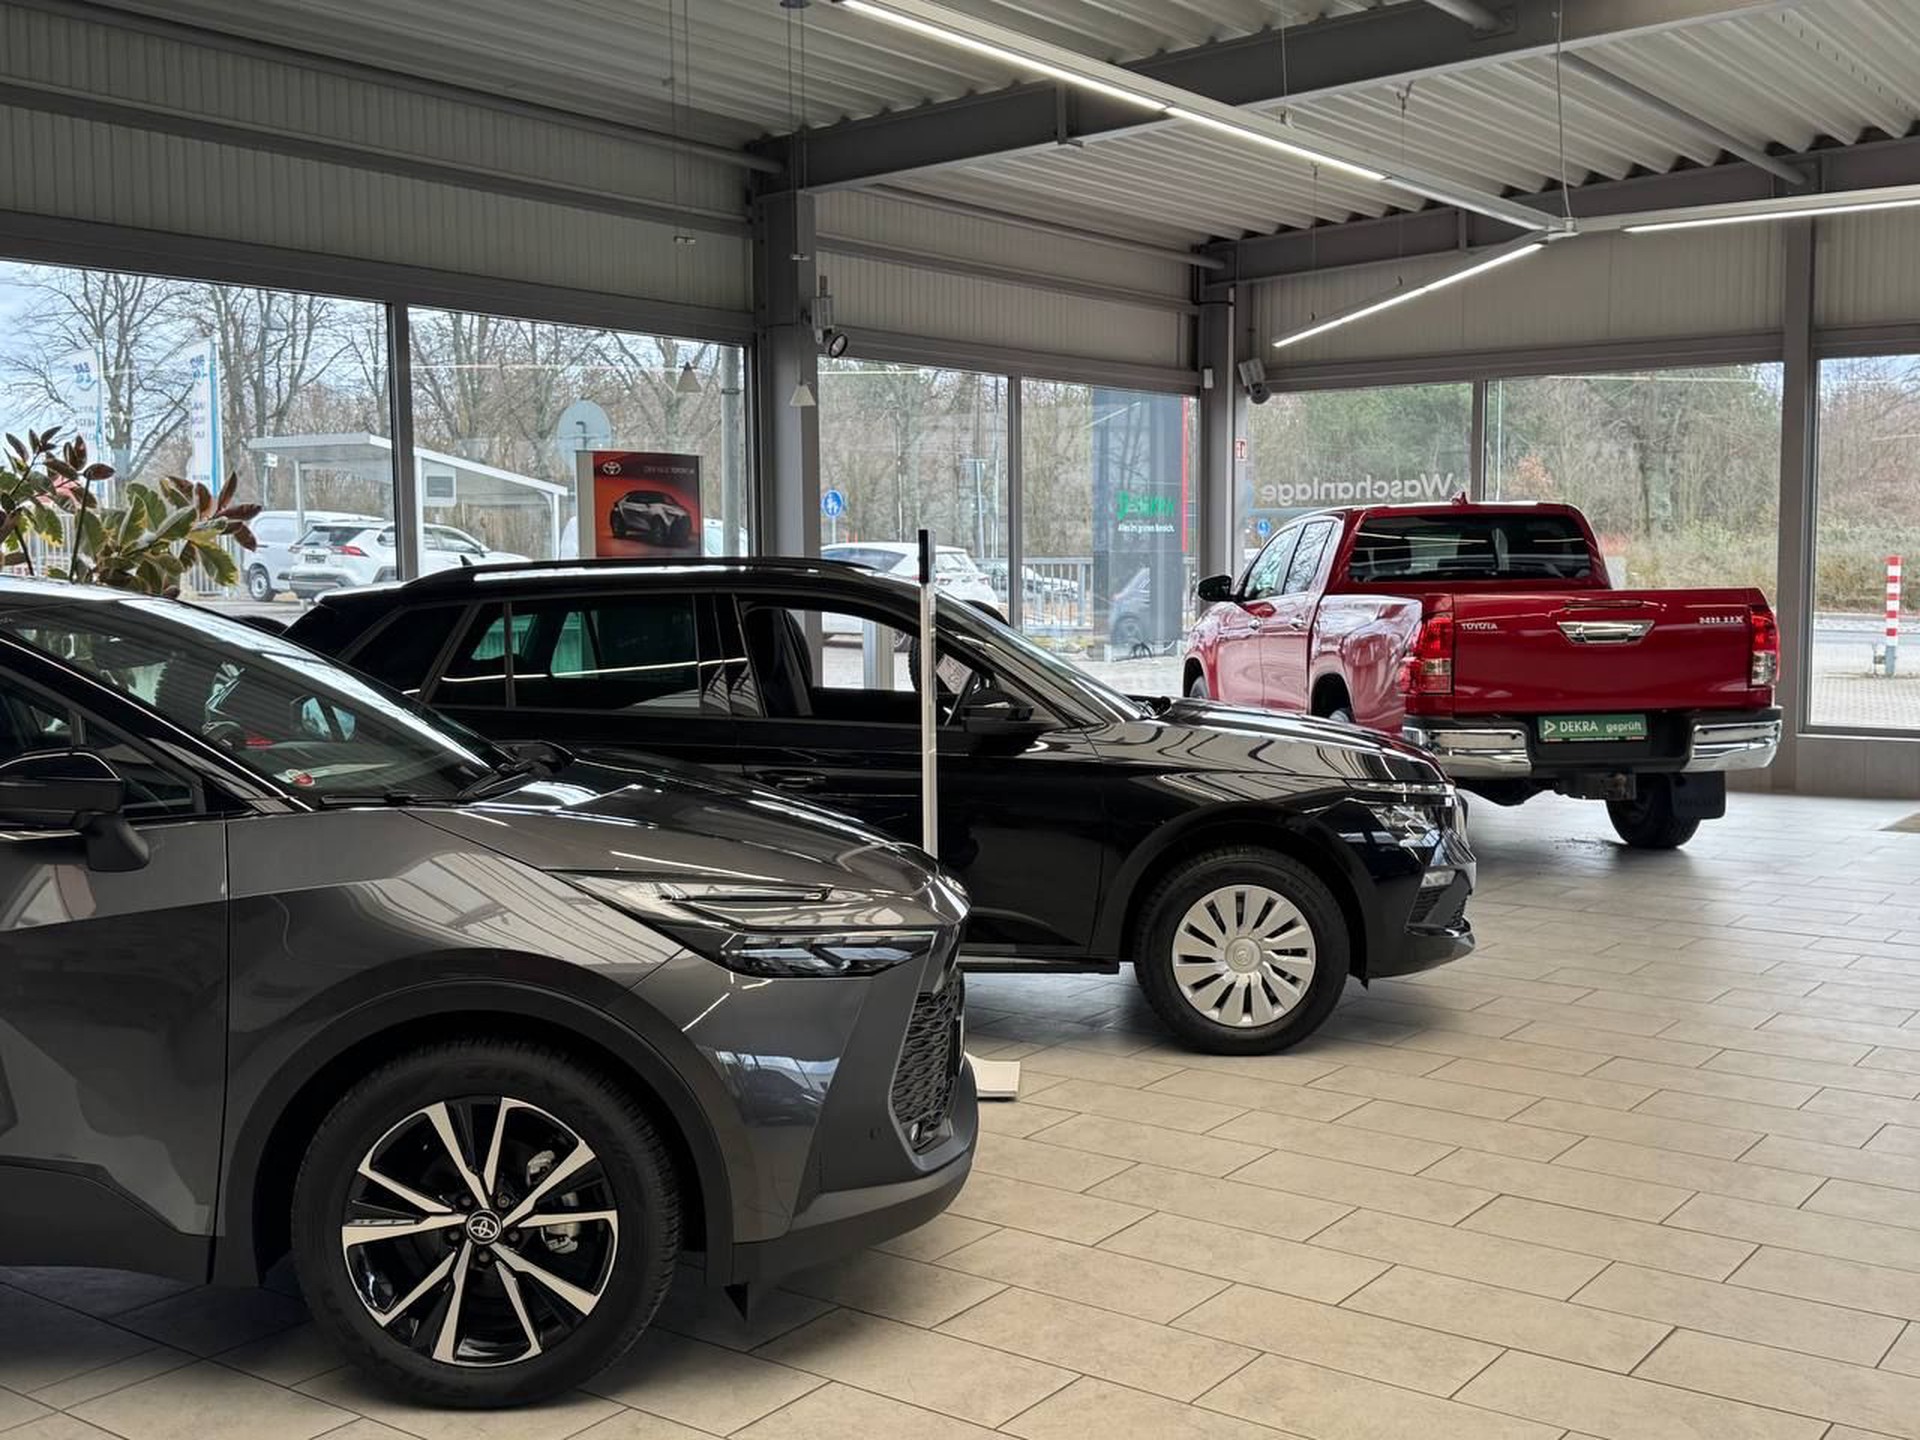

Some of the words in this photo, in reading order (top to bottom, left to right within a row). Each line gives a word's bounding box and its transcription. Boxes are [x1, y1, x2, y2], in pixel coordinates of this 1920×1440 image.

[1461, 622, 1498, 630] TOYOTA
[1560, 721, 1599, 733] DEKRA
[1606, 720, 1643, 734] geprüft
